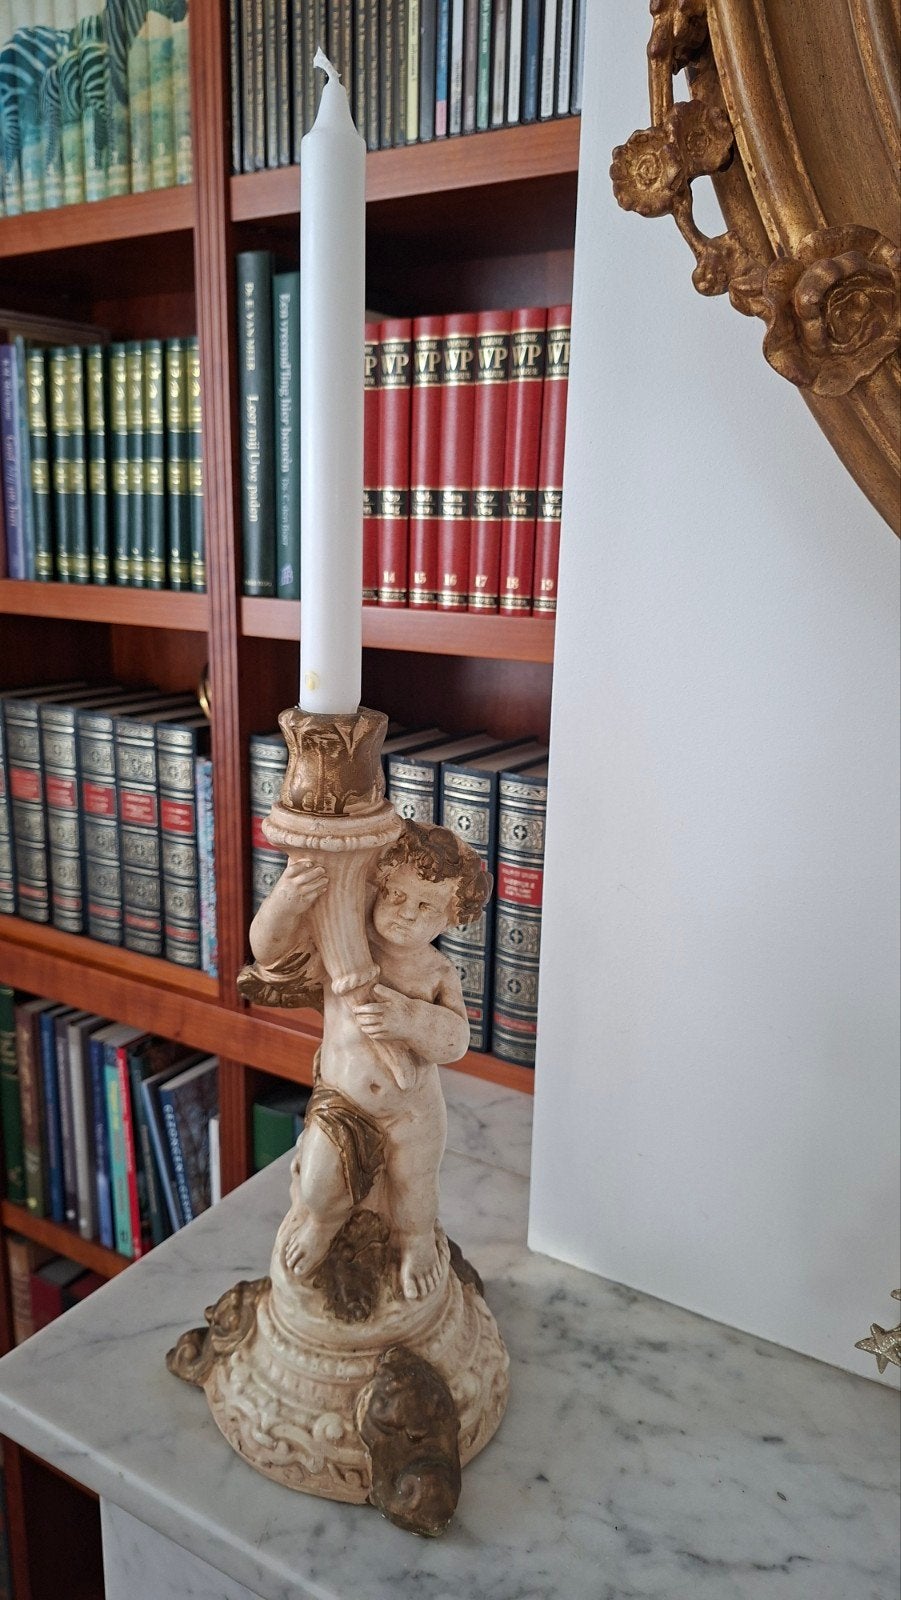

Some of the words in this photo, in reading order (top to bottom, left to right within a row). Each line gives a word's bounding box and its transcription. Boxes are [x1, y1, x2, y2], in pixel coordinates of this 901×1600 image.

[279, 293, 291, 319] Een
[245, 312, 255, 338] VAN
[245, 339, 256, 371] MEER
[380, 353, 409, 376] WP
[414, 352, 441, 373] WP
[444, 349, 474, 371] WP
[478, 347, 508, 370] WP
[512, 344, 542, 367] WP
[246, 393, 260, 426] Leer
[280, 398, 292, 425] hier
[246, 429, 260, 450] mij
[247, 451, 261, 483] Uwe
[246, 485, 260, 522] paden
[383, 571, 395, 583] 14
[414, 571, 427, 584] 15
[444, 573, 457, 586] 16
[475, 574, 488, 588] 17
[506, 576, 519, 589] 18
[541, 578, 554, 591] 19
